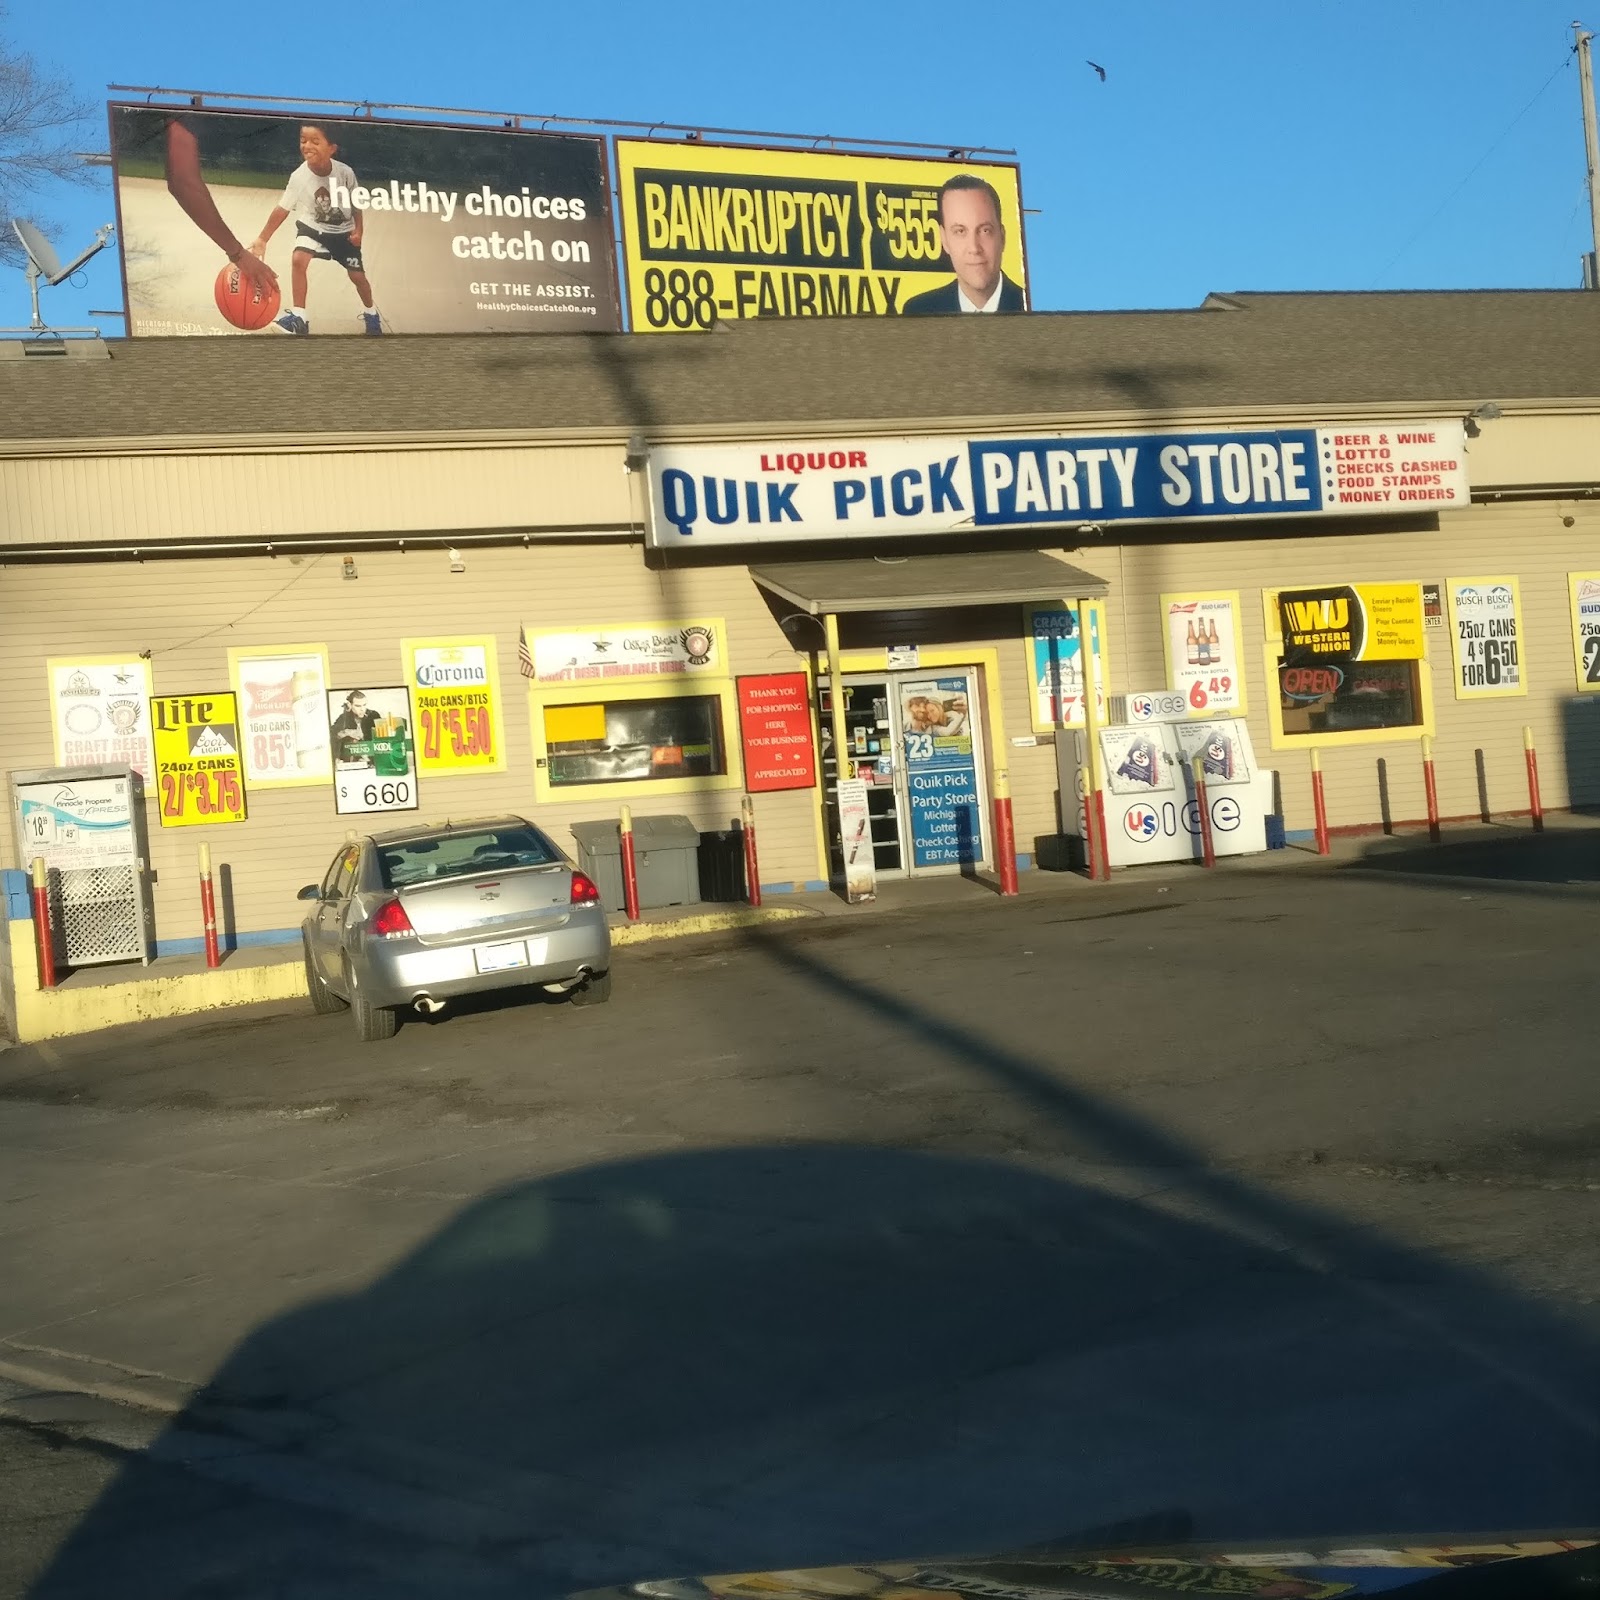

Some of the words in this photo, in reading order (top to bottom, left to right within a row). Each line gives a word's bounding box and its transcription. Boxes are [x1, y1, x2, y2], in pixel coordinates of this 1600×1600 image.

[329, 177, 457, 222] healthy
[465, 186, 587, 221] choices
[643, 182, 852, 258] BANKRUPTCY
[876, 190, 941, 260] $555
[452, 230, 545, 261] catch
[551, 239, 591, 262] on
[346, 257, 360, 268] 22
[470, 282, 498, 295] GET
[503, 283, 532, 296] THE
[536, 285, 595, 298] ASSIST.
[476, 302, 597, 315] HealthyChoicesCatchOn.org
[175, 323, 202, 333] USDA
[1334, 434, 1371, 446] BEER
[1379, 434, 1389, 445] &
[1397, 432, 1436, 444] WINE
[1335, 448, 1391, 461] LOTTO
[760, 450, 867, 474] LIQUOR
[1337, 462, 1394, 475] CHECKS
[1401, 460, 1457, 472] CASHED
[1338, 476, 1375, 487] FOOD
[1382, 474, 1441, 486] STAMPS
[662, 468, 803, 535] QUIK
[833, 454, 965, 520] PICK
[982, 446, 1138, 514] PARTY
[1160, 442, 1310, 507] STORE
[1339, 490, 1391, 503] MONEY
[1399, 488, 1455, 501] ORDERS
[1456, 596, 1483, 606] BUSCH
[1487, 594, 1513, 604] BUSCH
[1292, 598, 1349, 631] WU
[1581, 604, 1600, 613] BUD
[1034, 616, 1072, 628] CRACK
[1425, 617, 1441, 626] ENTER
[1063, 626, 1098, 639] OPN
[1459, 620, 1485, 639] 25oz
[1489, 618, 1516, 637] CANS
[1294, 632, 1350, 645] WESTERN
[1313, 641, 1351, 653] UNION
[1468, 641, 1476, 662] 4
[416, 664, 484, 686] Corona
[1285, 668, 1338, 693] OPEN
[1462, 664, 1484, 686] FOR
[750, 688, 779, 698] THANK
[779, 687, 796, 696] YOU
[254, 702, 274, 710] HIGH
[274, 702, 290, 710] LIFE
[418, 696, 438, 707] 24oz
[441, 693, 488, 707] CANS/BTLS
[746, 706, 762, 714] FOR
[762, 703, 803, 713] SHOPPING
[153, 699, 213, 732] Lite
[250, 722, 267, 732] 16oz
[269, 721, 290, 732] CANS
[765, 720, 786, 729] HERE
[421, 706, 491, 758] 2/$5.50
[65, 740, 108, 753] CRAFT
[113, 736, 147, 750] BEER
[196, 736, 228, 748] Coors
[373, 742, 393, 751] KOOL
[747, 738, 770, 746] YOUR
[771, 735, 807, 744] BUSINESS
[201, 746, 223, 754] LIGHT
[775, 753, 782, 761] IS
[161, 762, 194, 772] 24oz
[197, 758, 235, 770] CANS
[754, 768, 807, 779] APPRECIATED
[913, 775, 943, 790] Quik
[944, 773, 968, 787] Pick
[162, 770, 242, 816] 2/$3.75
[341, 786, 348, 798] $
[364, 782, 409, 806] 6.60
[56, 800, 83, 808] Pinnacle
[85, 798, 112, 806] Propane
[912, 795, 943, 808] Party
[945, 792, 976, 806] Store
[78, 805, 128, 818] EXPRESS
[1128, 810, 1156, 835] us
[915, 837, 943, 848] Check
[925, 849, 943, 860] EBT
